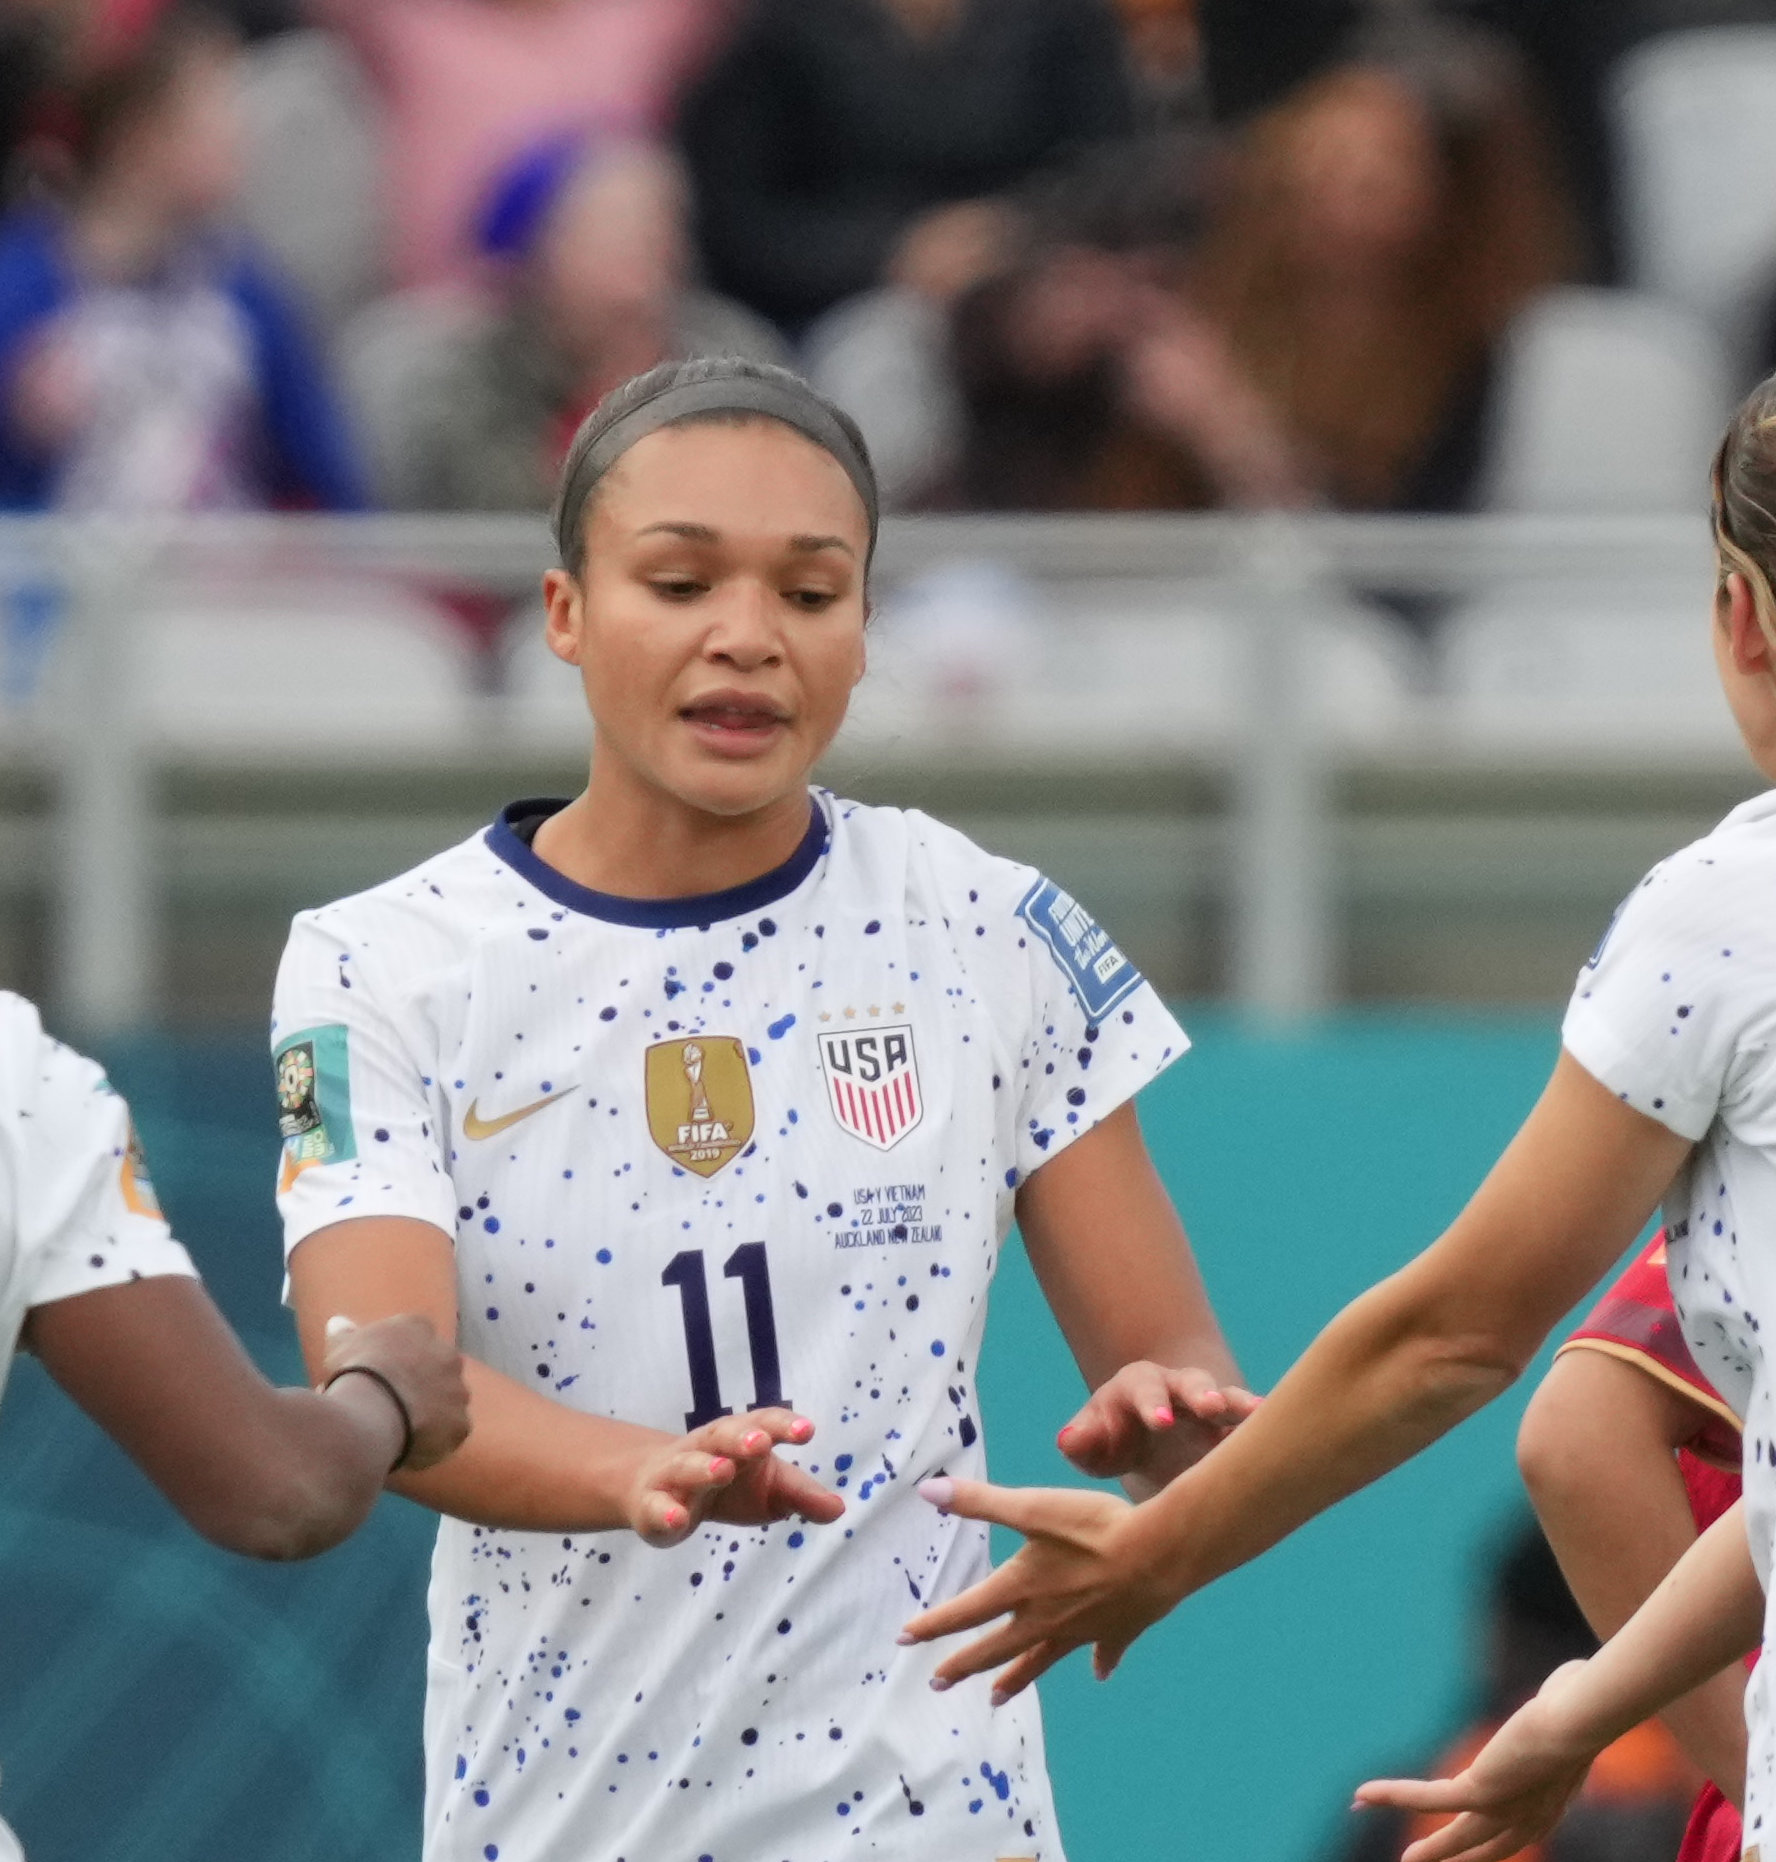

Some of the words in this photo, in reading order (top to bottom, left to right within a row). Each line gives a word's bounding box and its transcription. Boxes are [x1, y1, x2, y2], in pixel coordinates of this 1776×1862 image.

[827, 1034, 908, 1083] USA
[678, 1122, 728, 1144] FIFA
[690, 1147, 722, 1161] 2019
[884, 1184, 926, 1202] VIETNAM
[861, 1208, 874, 1226] 22
[877, 1206, 898, 1225] JULY
[901, 1204, 923, 1223] 2023
[835, 1229, 886, 1249] AUCKLAND
[661, 1241, 793, 1434] 11
